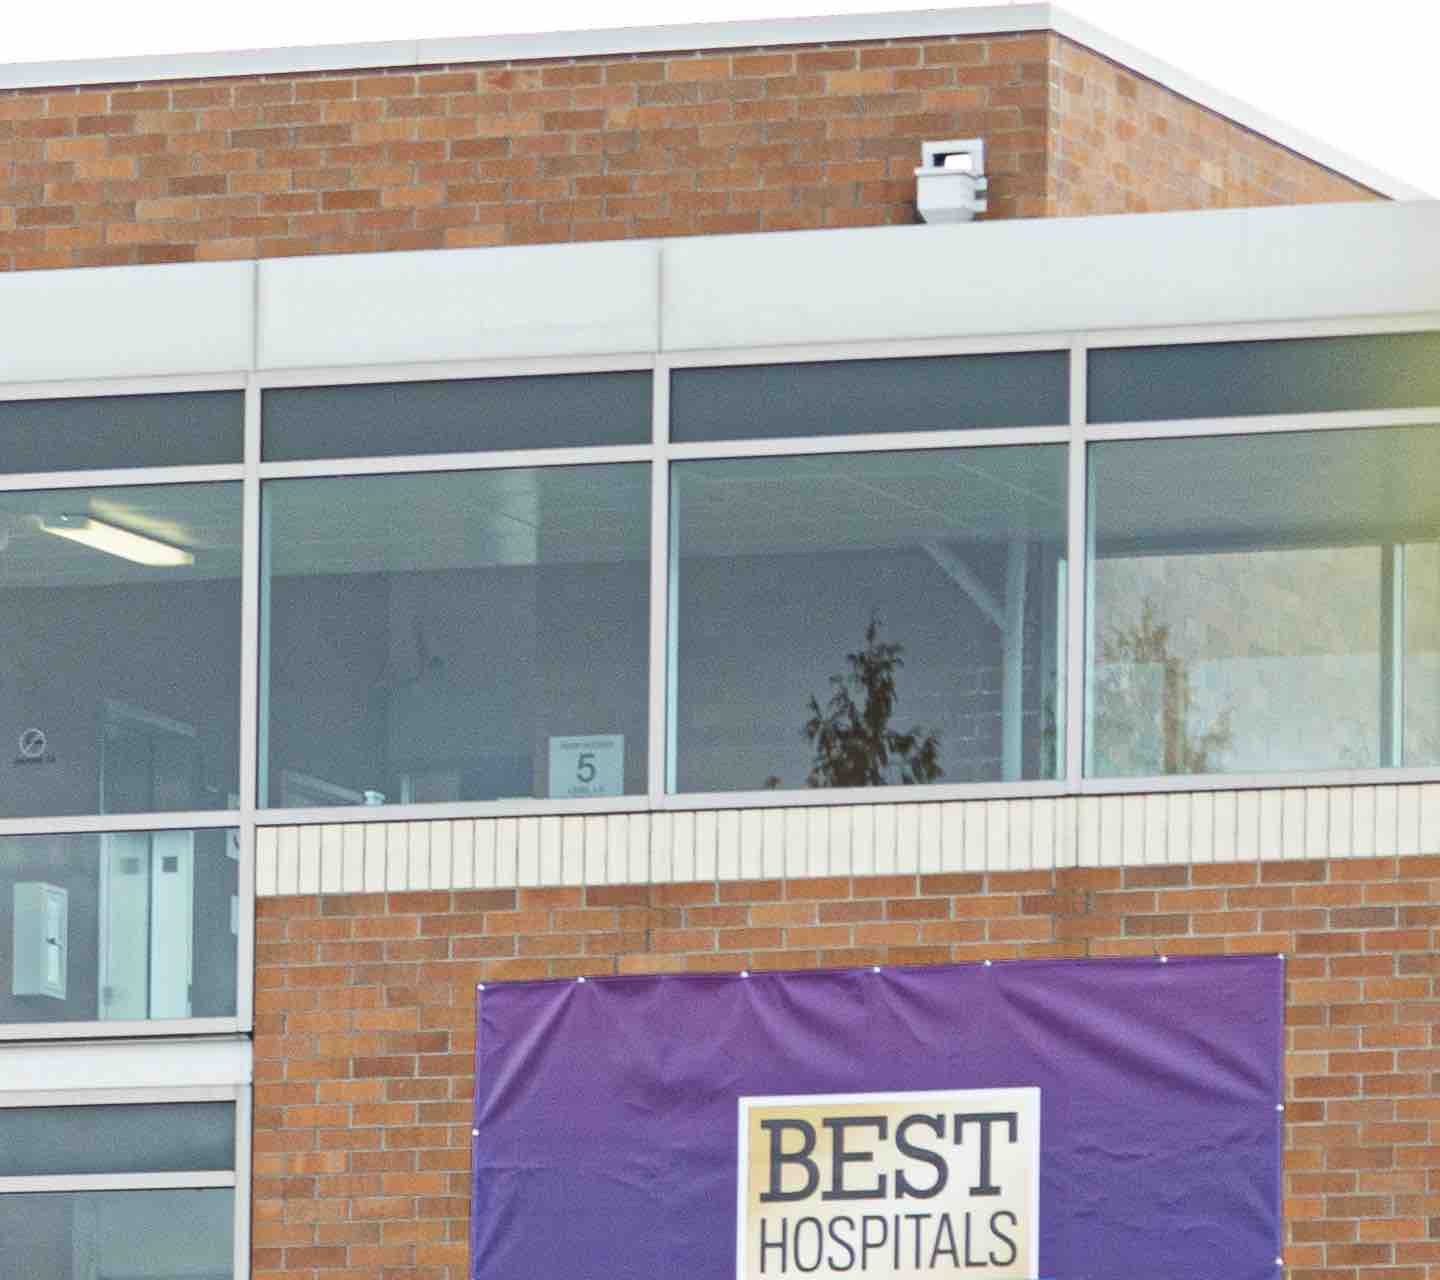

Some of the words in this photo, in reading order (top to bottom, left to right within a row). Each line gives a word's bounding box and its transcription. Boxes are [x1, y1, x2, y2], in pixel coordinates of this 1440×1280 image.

[576, 752, 597, 784] 5
[759, 1112, 1018, 1203] BEST
[759, 1210, 1018, 1274] HOSPITALS
